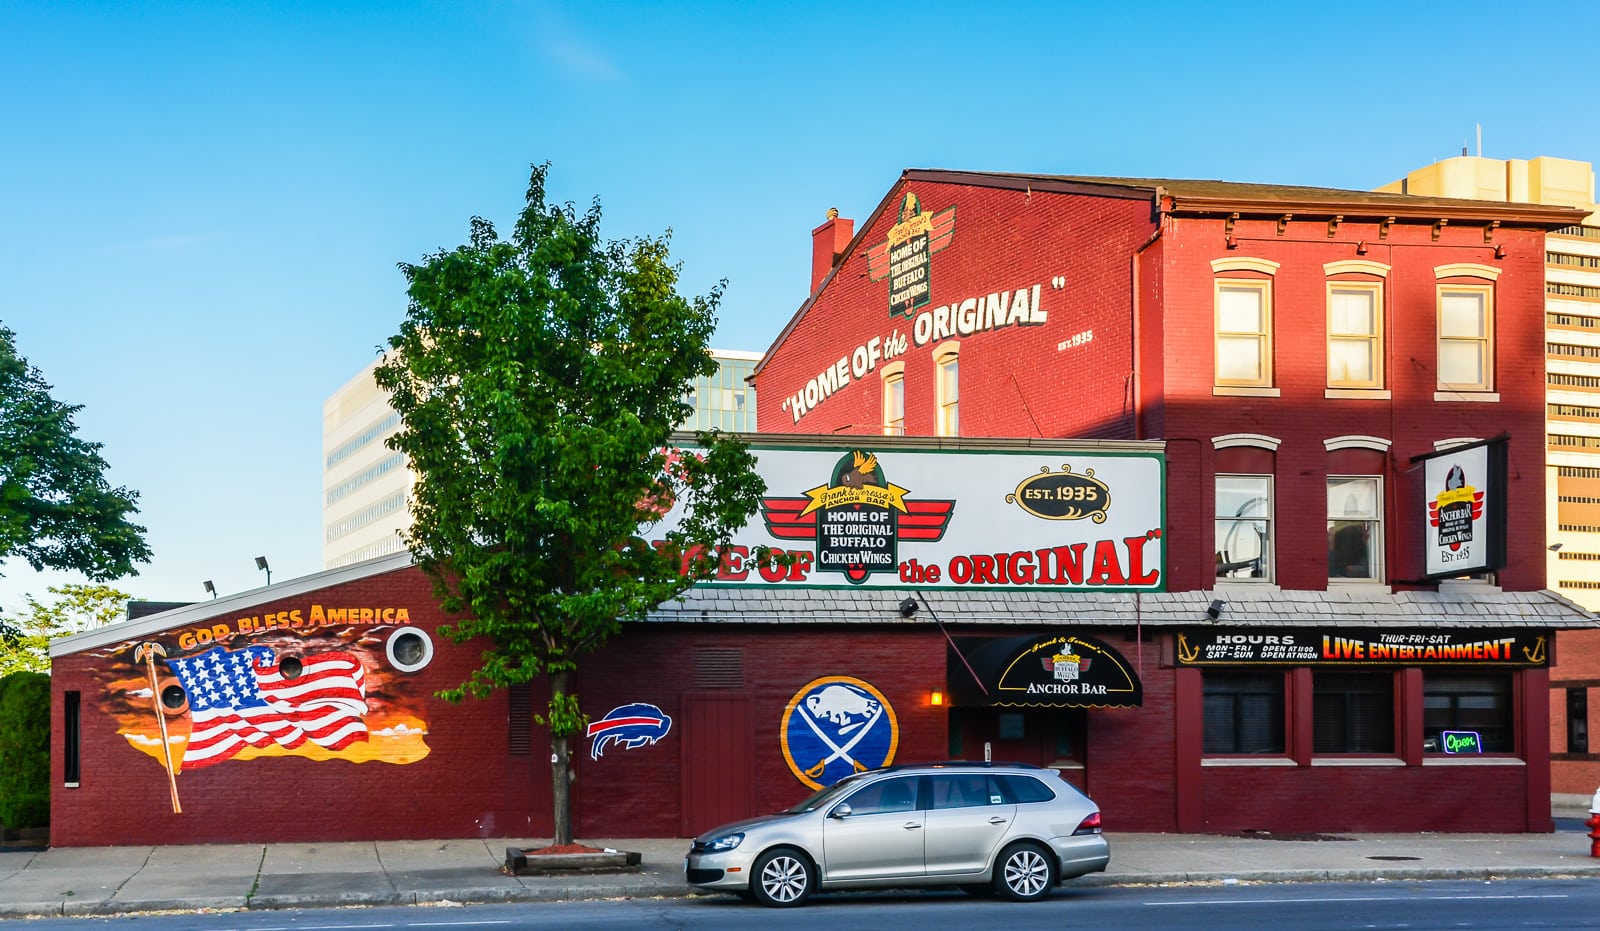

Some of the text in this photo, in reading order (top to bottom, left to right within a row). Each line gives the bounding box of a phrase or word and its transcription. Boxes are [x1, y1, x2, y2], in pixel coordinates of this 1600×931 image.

[890, 237, 927, 264] HOME OF
[852, 336, 881, 380] OF
[883, 328, 909, 360] the
[819, 488, 847, 503] Frank
[1025, 486, 1098, 501] EST. 1935
[827, 496, 886, 507] ANCHOR BAR
[827, 511, 889, 522] HOME OF
[822, 524, 893, 536] THE ORIGINAL
[830, 537, 886, 548] BUFFALO
[757, 547, 815, 582] OF
[898, 558, 941, 584] the
[178, 604, 411, 650] GOD BLESS AMERICA
[1216, 635, 1294, 645] HOURS
[1380, 634, 1452, 644] THUR-FRI-SAT
[1288, 645, 1300, 653] AT
[1323, 634, 1516, 660] LIVE ENTERTAINMENT
[1260, 651, 1286, 659] OPEN
[1026, 682, 1107, 695] ANCHOR BAR
[1446, 734, 1476, 753] Open
